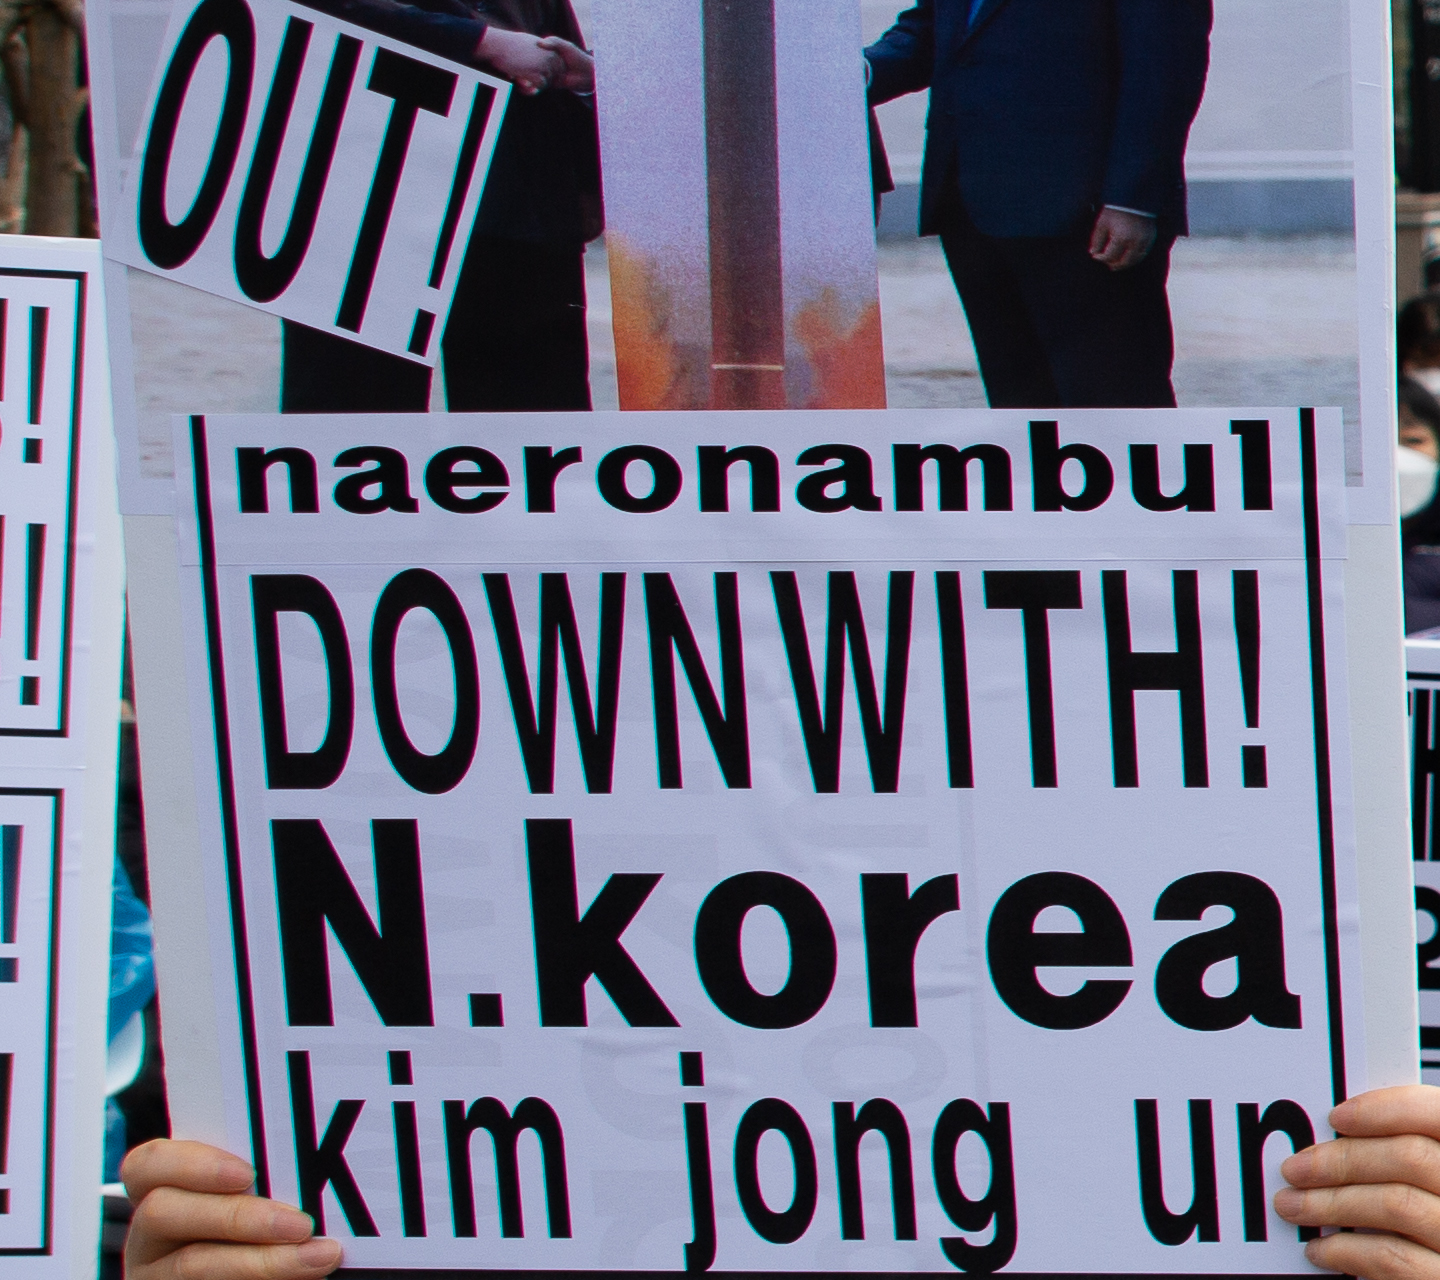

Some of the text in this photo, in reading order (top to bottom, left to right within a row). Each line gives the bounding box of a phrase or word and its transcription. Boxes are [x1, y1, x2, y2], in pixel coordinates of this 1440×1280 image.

[236, 420, 1273, 513] naeronambul
[270, 817, 1303, 1030] N.korea
[286, 1050, 1322, 1273] kim jong un
